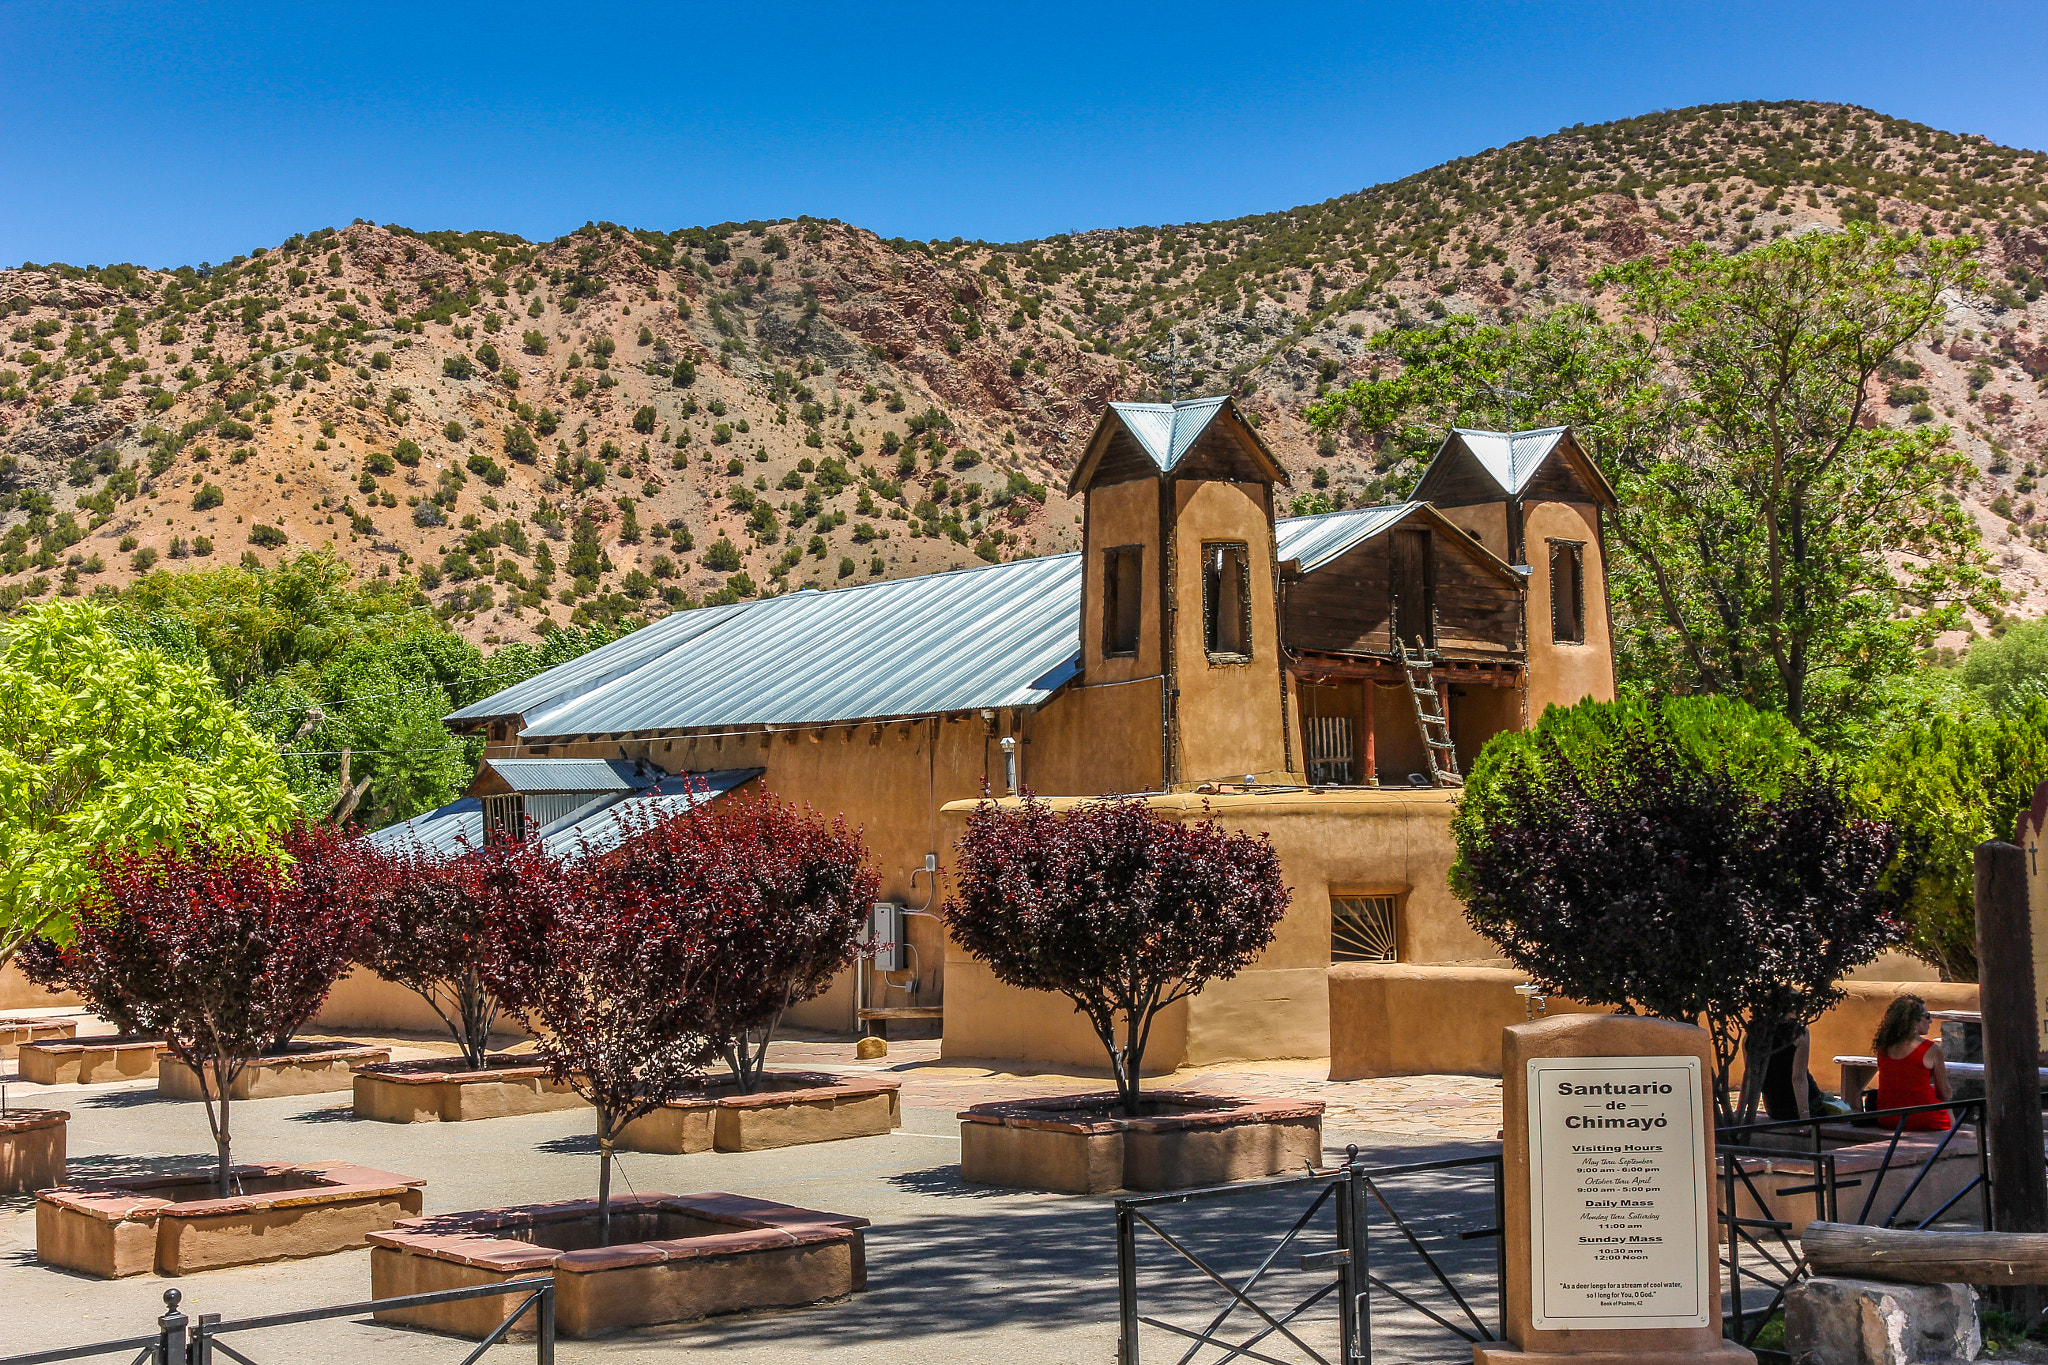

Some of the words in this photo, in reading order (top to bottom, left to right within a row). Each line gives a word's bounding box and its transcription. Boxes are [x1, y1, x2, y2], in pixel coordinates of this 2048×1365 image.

[1558, 1081, 1673, 1096] Santuario
[1605, 1101, 1627, 1110] de
[1565, 1112, 1668, 1131] Chimayó
[1571, 1145, 1622, 1153] Visiting
[1624, 1144, 1663, 1152] Hours
[1582, 1158, 1599, 1166] May
[1618, 1157, 1653, 1166] September
[1584, 1177, 1614, 1185] October
[1631, 1176, 1652, 1186] April
[1580, 1212, 1608, 1221] Monday
[1627, 1212, 1660, 1220] Saturday
[1578, 1236, 1626, 1244] Sunday
[1590, 1282, 1607, 1290] longs
[1663, 1281, 1683, 1289] water,
[1597, 1292, 1611, 1300] long
[1620, 1291, 1634, 1299] You,
